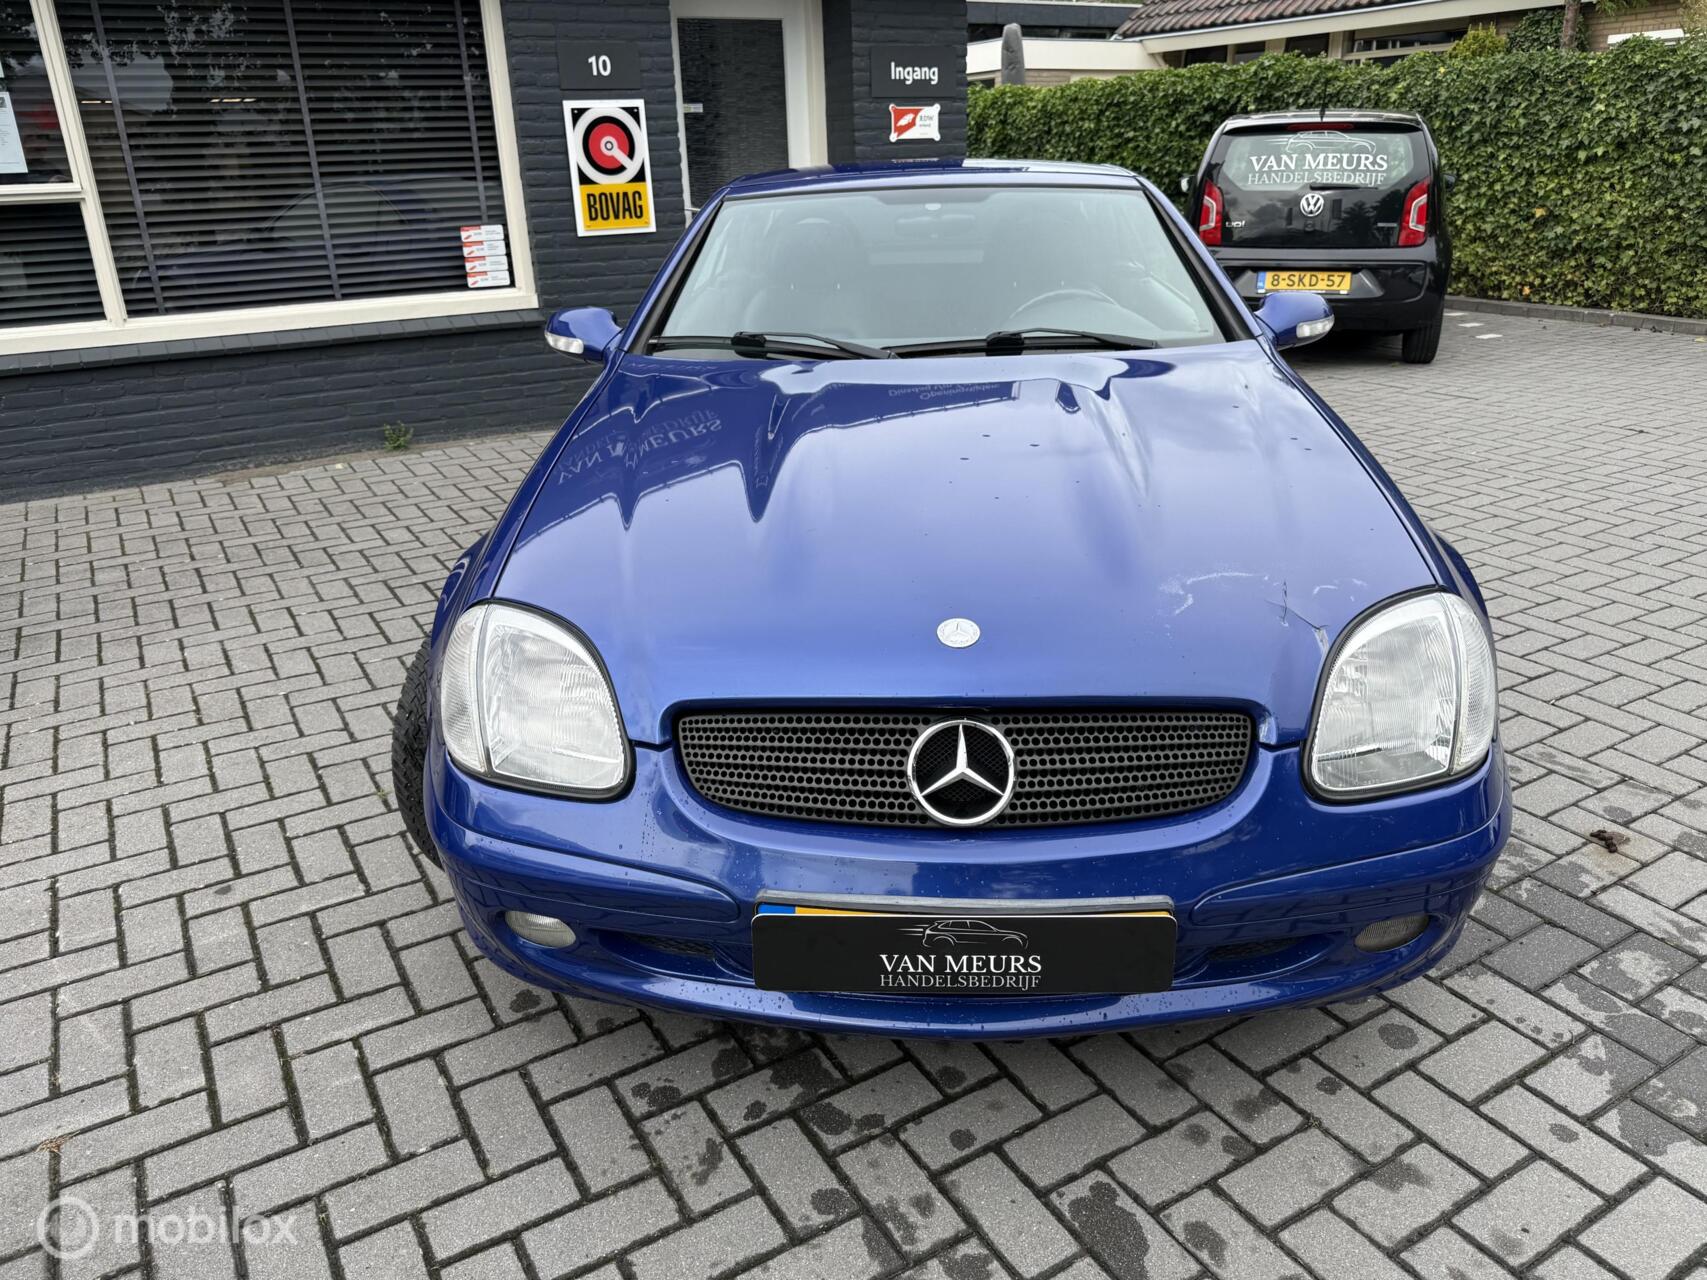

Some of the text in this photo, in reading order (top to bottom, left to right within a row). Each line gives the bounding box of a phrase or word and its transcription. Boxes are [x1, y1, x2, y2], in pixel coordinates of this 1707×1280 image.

[588, 54, 612, 77] 10
[890, 61, 939, 85] Ingang
[1250, 153, 1388, 172] VAN MEURS
[1248, 171, 1387, 187] HANDELSBEDRIJF
[586, 190, 644, 222] BOVAG
[1270, 273, 1346, 288] 8-SKD-57
[879, 953, 1042, 974] VAN MEURS
[879, 974, 1041, 991] HANDELSBEDRIJF
